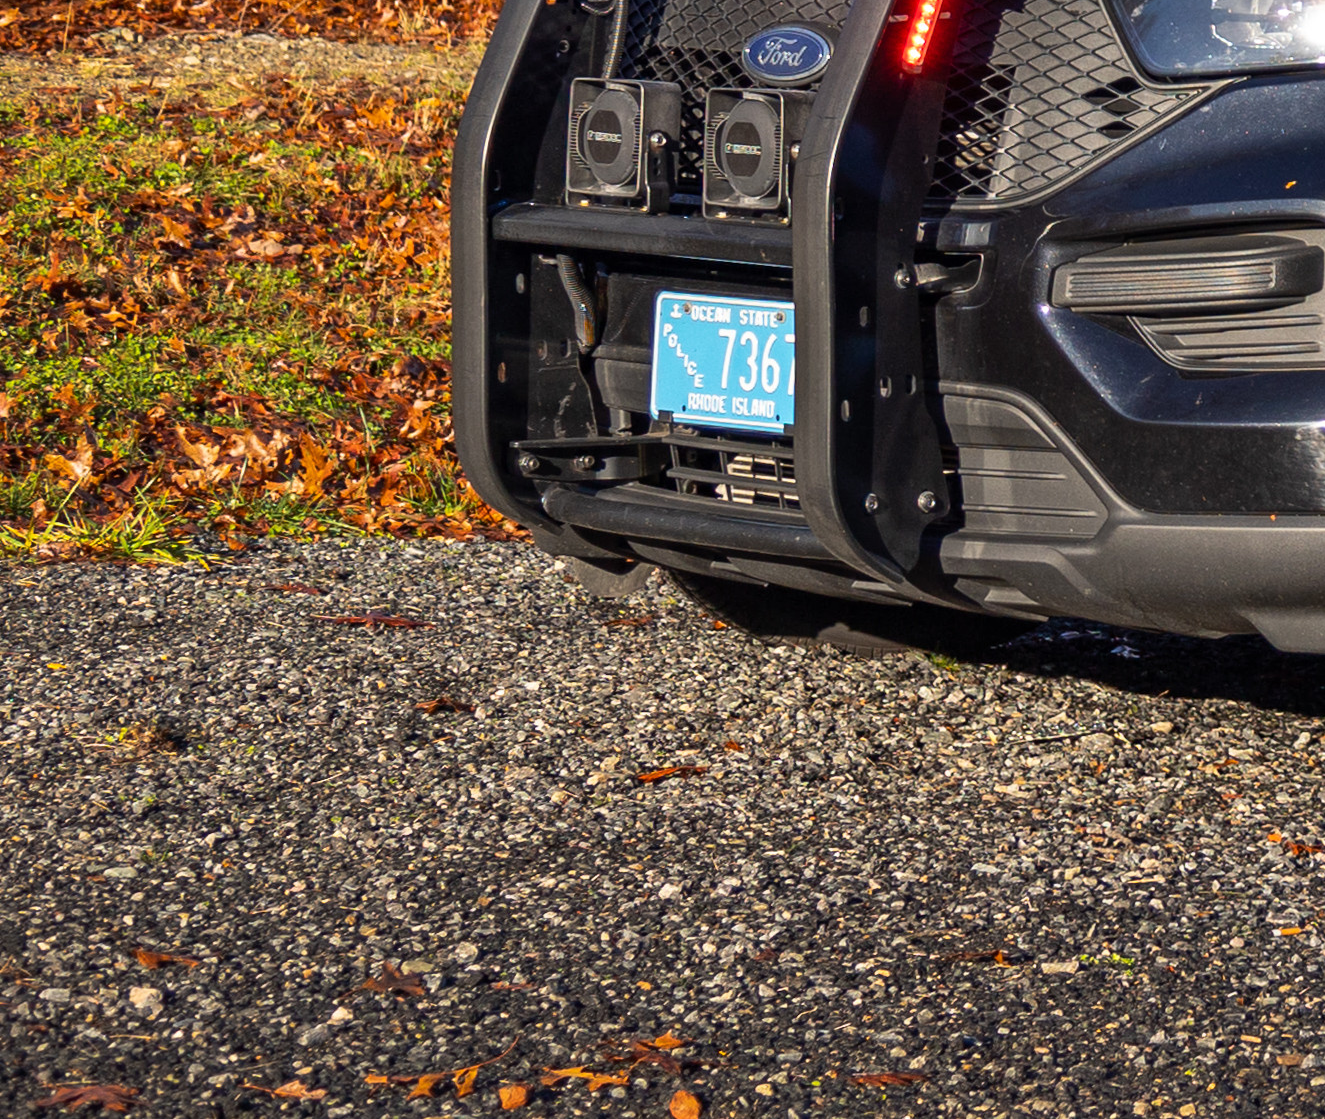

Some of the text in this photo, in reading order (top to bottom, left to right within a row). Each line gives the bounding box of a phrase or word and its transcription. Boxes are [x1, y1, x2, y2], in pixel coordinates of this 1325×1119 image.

[758, 36, 807, 66] Ford
[691, 305, 778, 328] OCEAN STATE
[663, 323, 704, 388] POLICE
[688, 393, 775, 419] RHODE ISLAND
